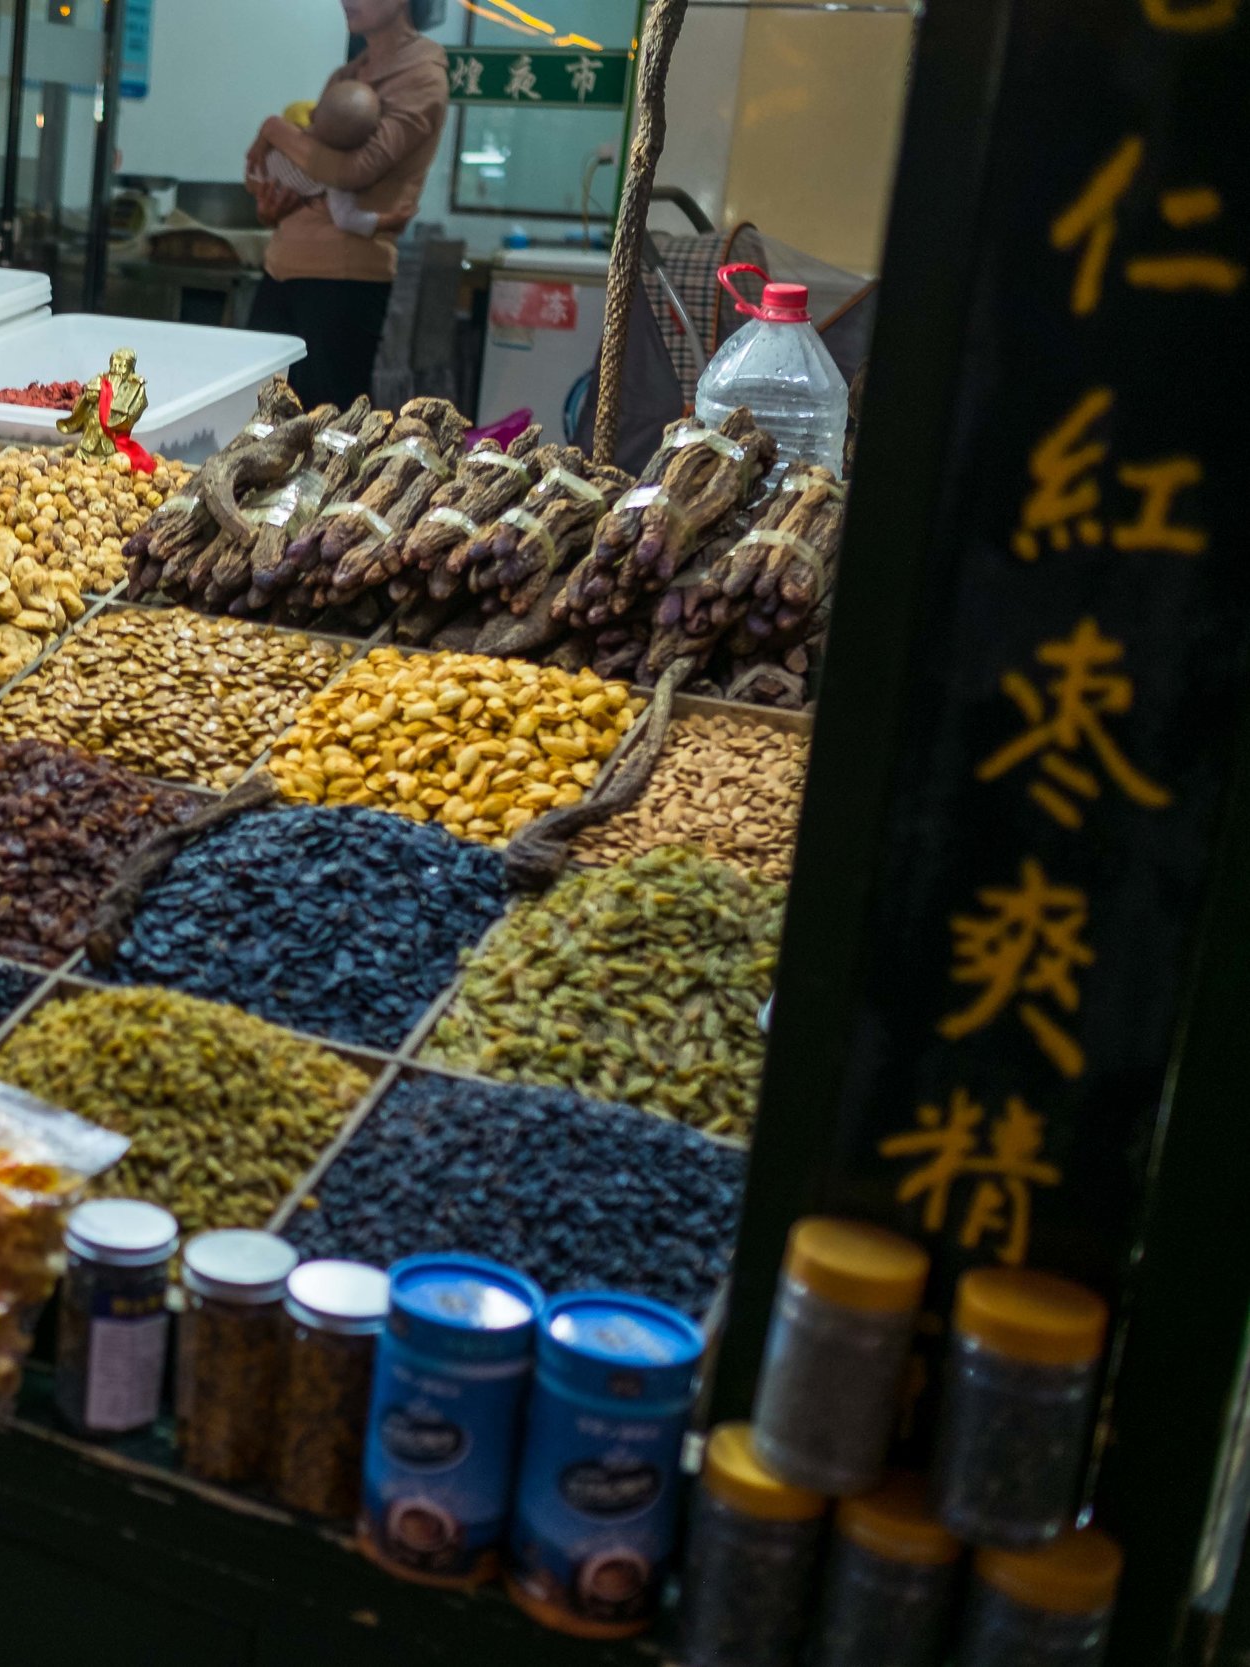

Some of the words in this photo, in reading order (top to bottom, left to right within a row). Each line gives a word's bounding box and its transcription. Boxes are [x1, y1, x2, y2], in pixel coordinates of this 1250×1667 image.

[450, 55, 604, 104] 煌夜市
[878, 0, 1239, 1442] 仁紅枣爽精
